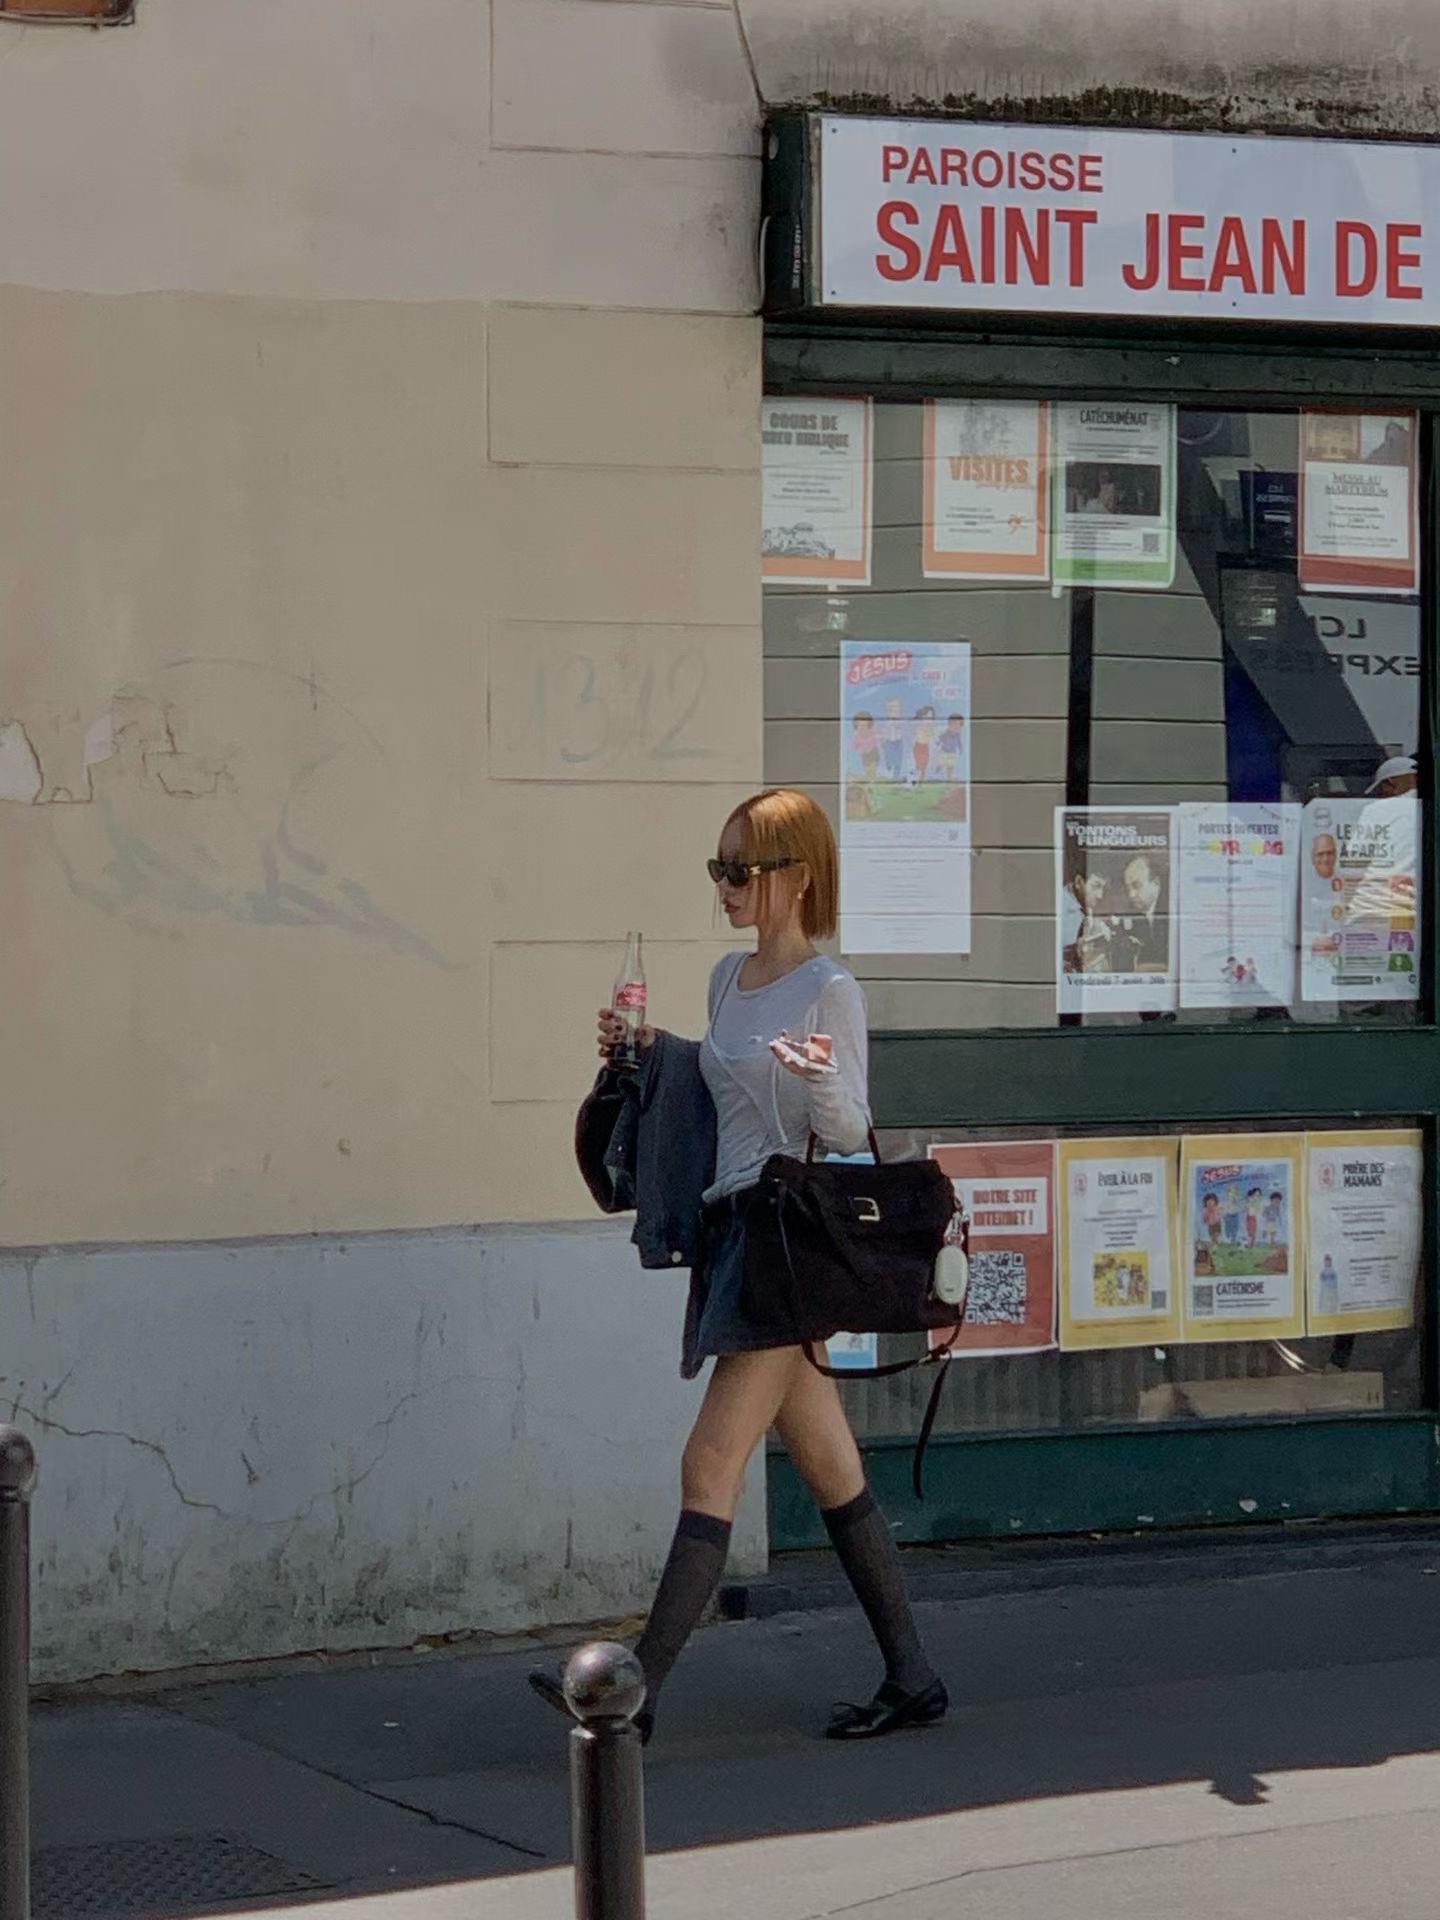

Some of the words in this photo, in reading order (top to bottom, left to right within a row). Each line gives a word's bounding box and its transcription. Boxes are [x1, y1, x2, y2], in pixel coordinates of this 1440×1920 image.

[882, 145, 1103, 192] PAROISSE
[875, 201, 1098, 287] SAINT
[1122, 213, 1305, 296] JEAN
[1335, 220, 1423, 300] DE
[820, 414, 839, 431] DE
[948, 455, 1029, 483] VISITES
[1066, 823, 1137, 837] TONTONS
[1336, 824, 1352, 840] LE
[1355, 824, 1391, 840] PAPE
[1078, 835, 1168, 847] FLINGUEURS
[1352, 843, 1388, 858] PARIS
[1370, 1163, 1385, 1174] DES
[1344, 1174, 1382, 1187] MAMANS
[973, 1190, 1010, 1204] NOTRE
[1014, 1189, 1037, 1203] SITE
[973, 1210, 1026, 1226] INTERNET
[1216, 1281, 1264, 1295] CATÉCHISME
